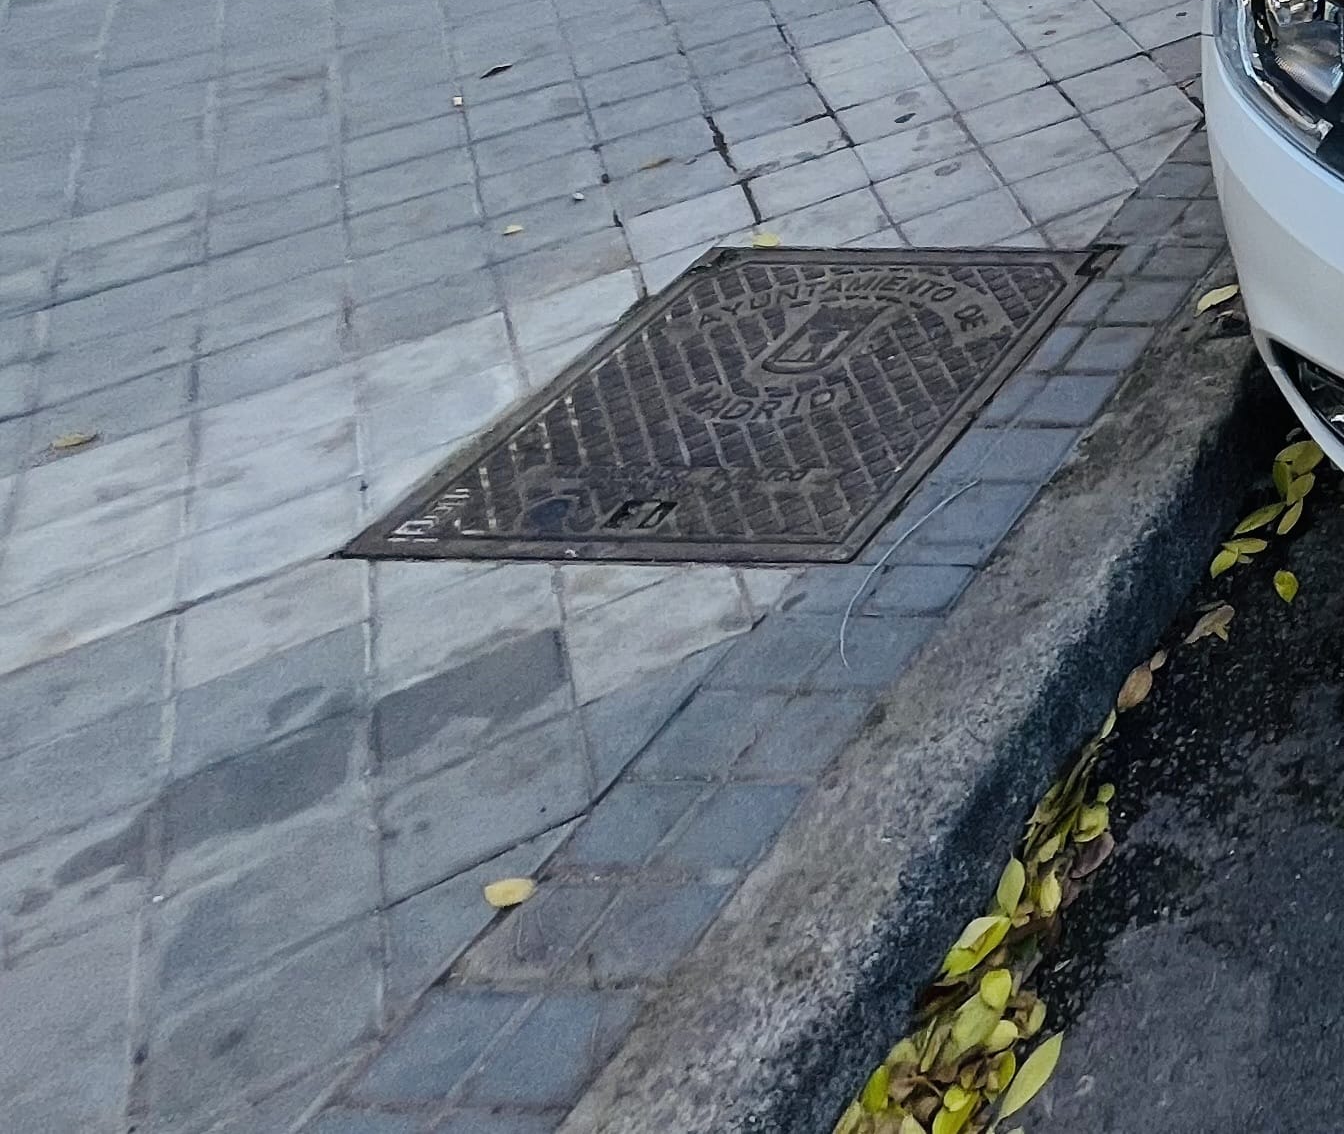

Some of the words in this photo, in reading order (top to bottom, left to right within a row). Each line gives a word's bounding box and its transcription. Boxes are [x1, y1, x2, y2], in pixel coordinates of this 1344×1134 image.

[701, 275, 958, 329] AYUNTAMIENTO
[954, 304, 988, 332] DE
[682, 386, 836, 421] MADRID
